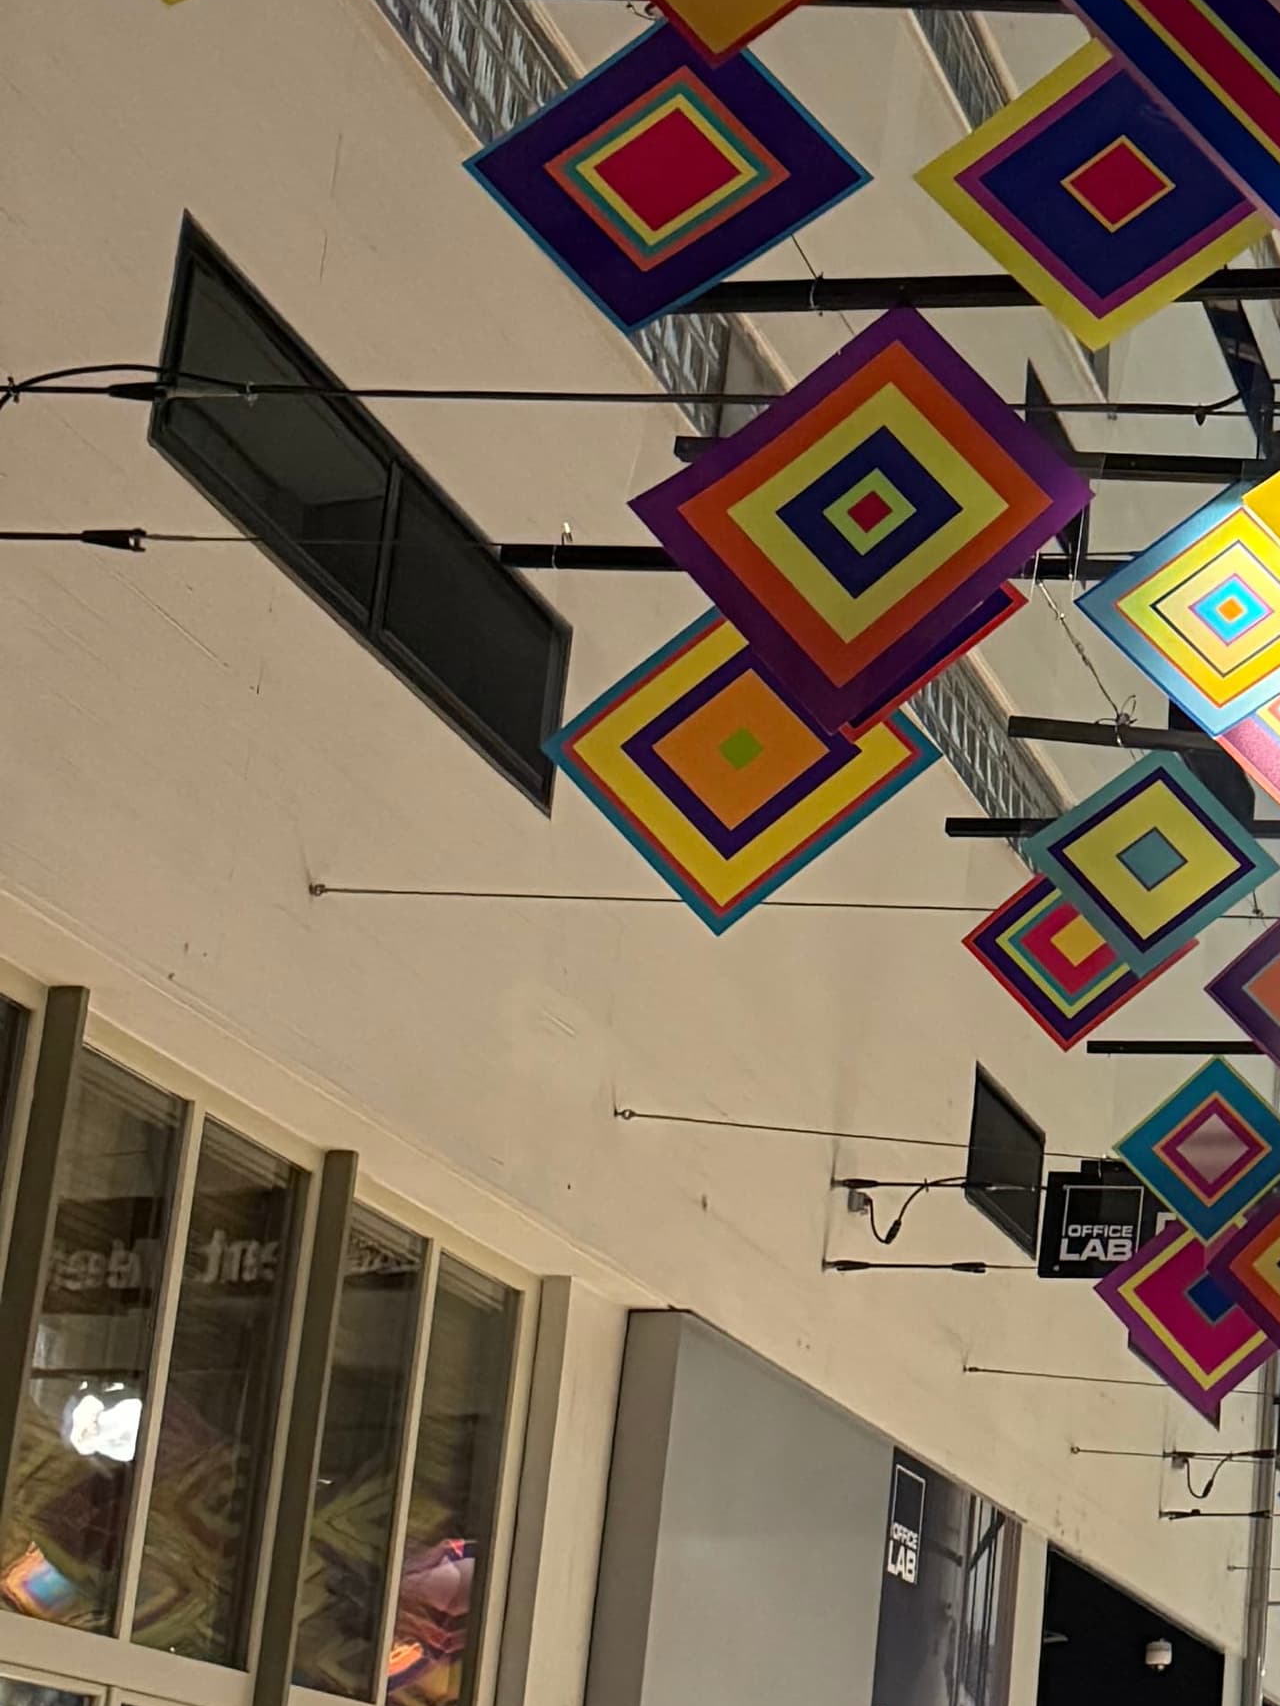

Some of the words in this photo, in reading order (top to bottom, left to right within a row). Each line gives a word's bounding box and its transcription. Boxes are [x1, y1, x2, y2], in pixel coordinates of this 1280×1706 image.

[1068, 1224, 1133, 1237] OFFICE
[1059, 1238, 1133, 1261] LAB
[893, 1522, 918, 1550] OFFICE
[887, 1539, 916, 1584] LAB
